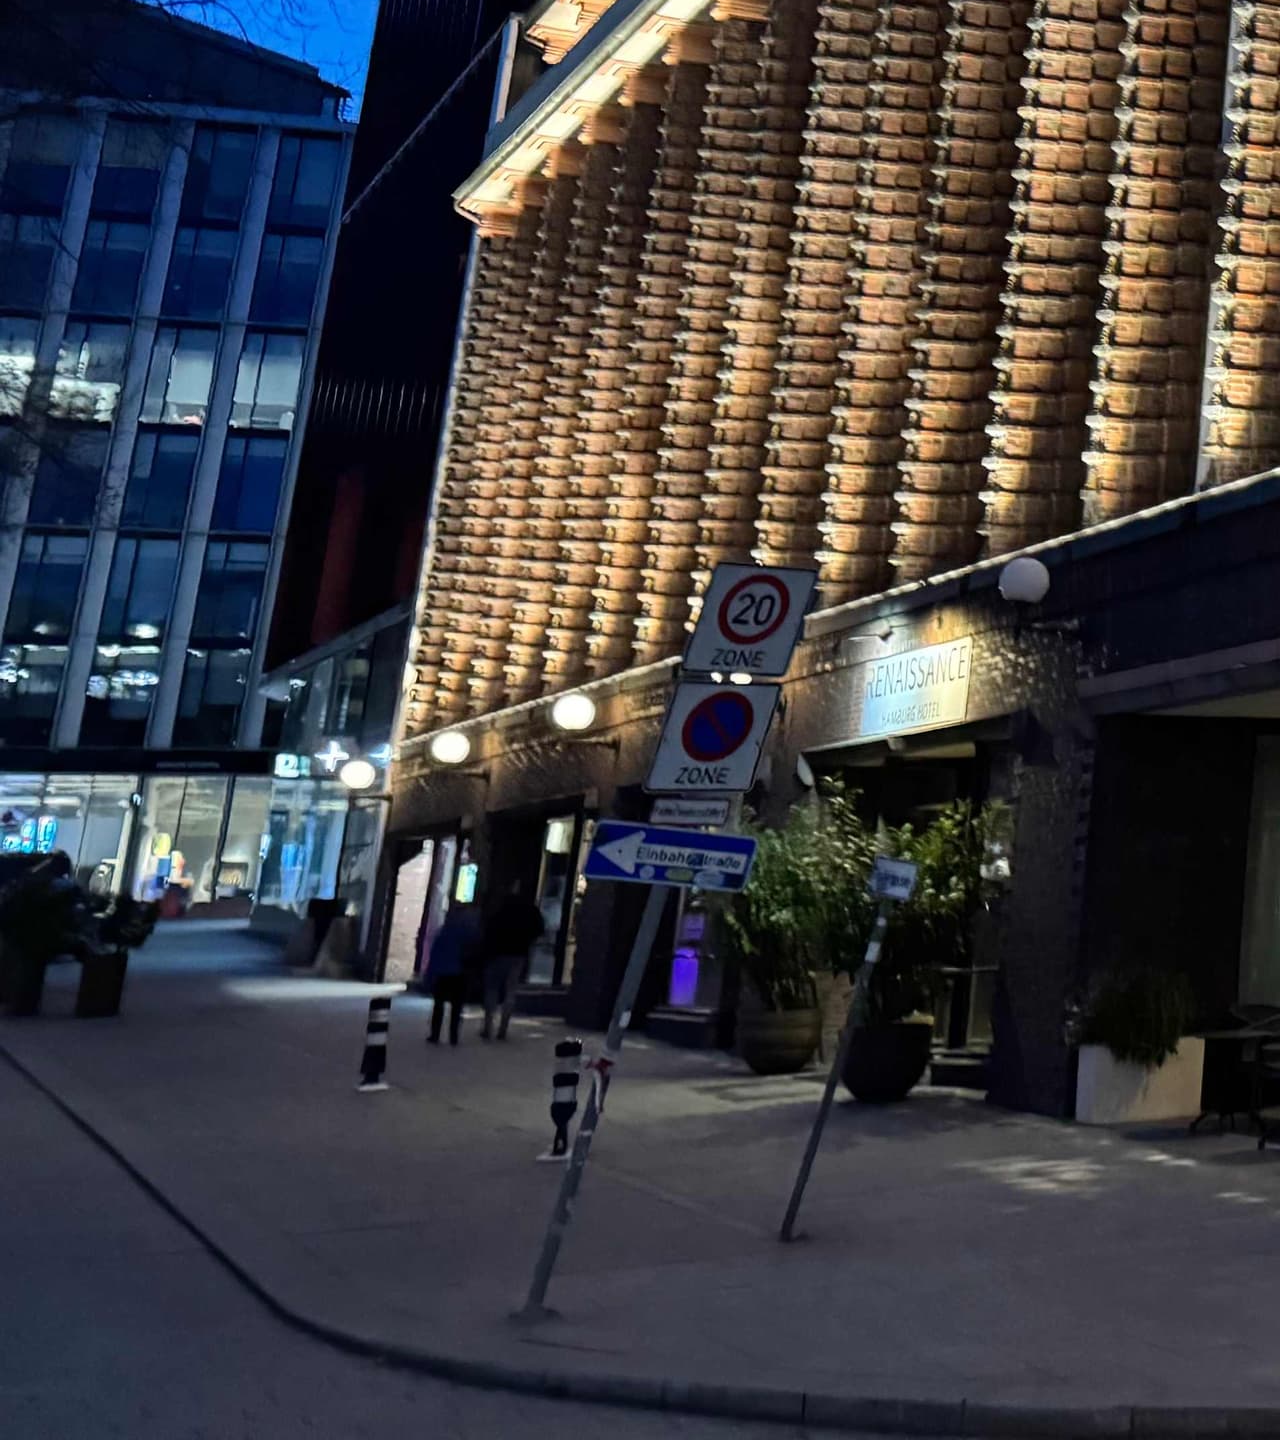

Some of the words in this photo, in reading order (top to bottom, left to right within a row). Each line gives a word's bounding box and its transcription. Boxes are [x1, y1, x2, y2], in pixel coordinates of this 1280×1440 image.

[731, 592, 776, 627] 20
[710, 647, 767, 668] ZONE
[865, 644, 968, 700] RENAISSANCE
[674, 766, 731, 785] ZONE
[635, 845, 742, 871] Einbahtraße
